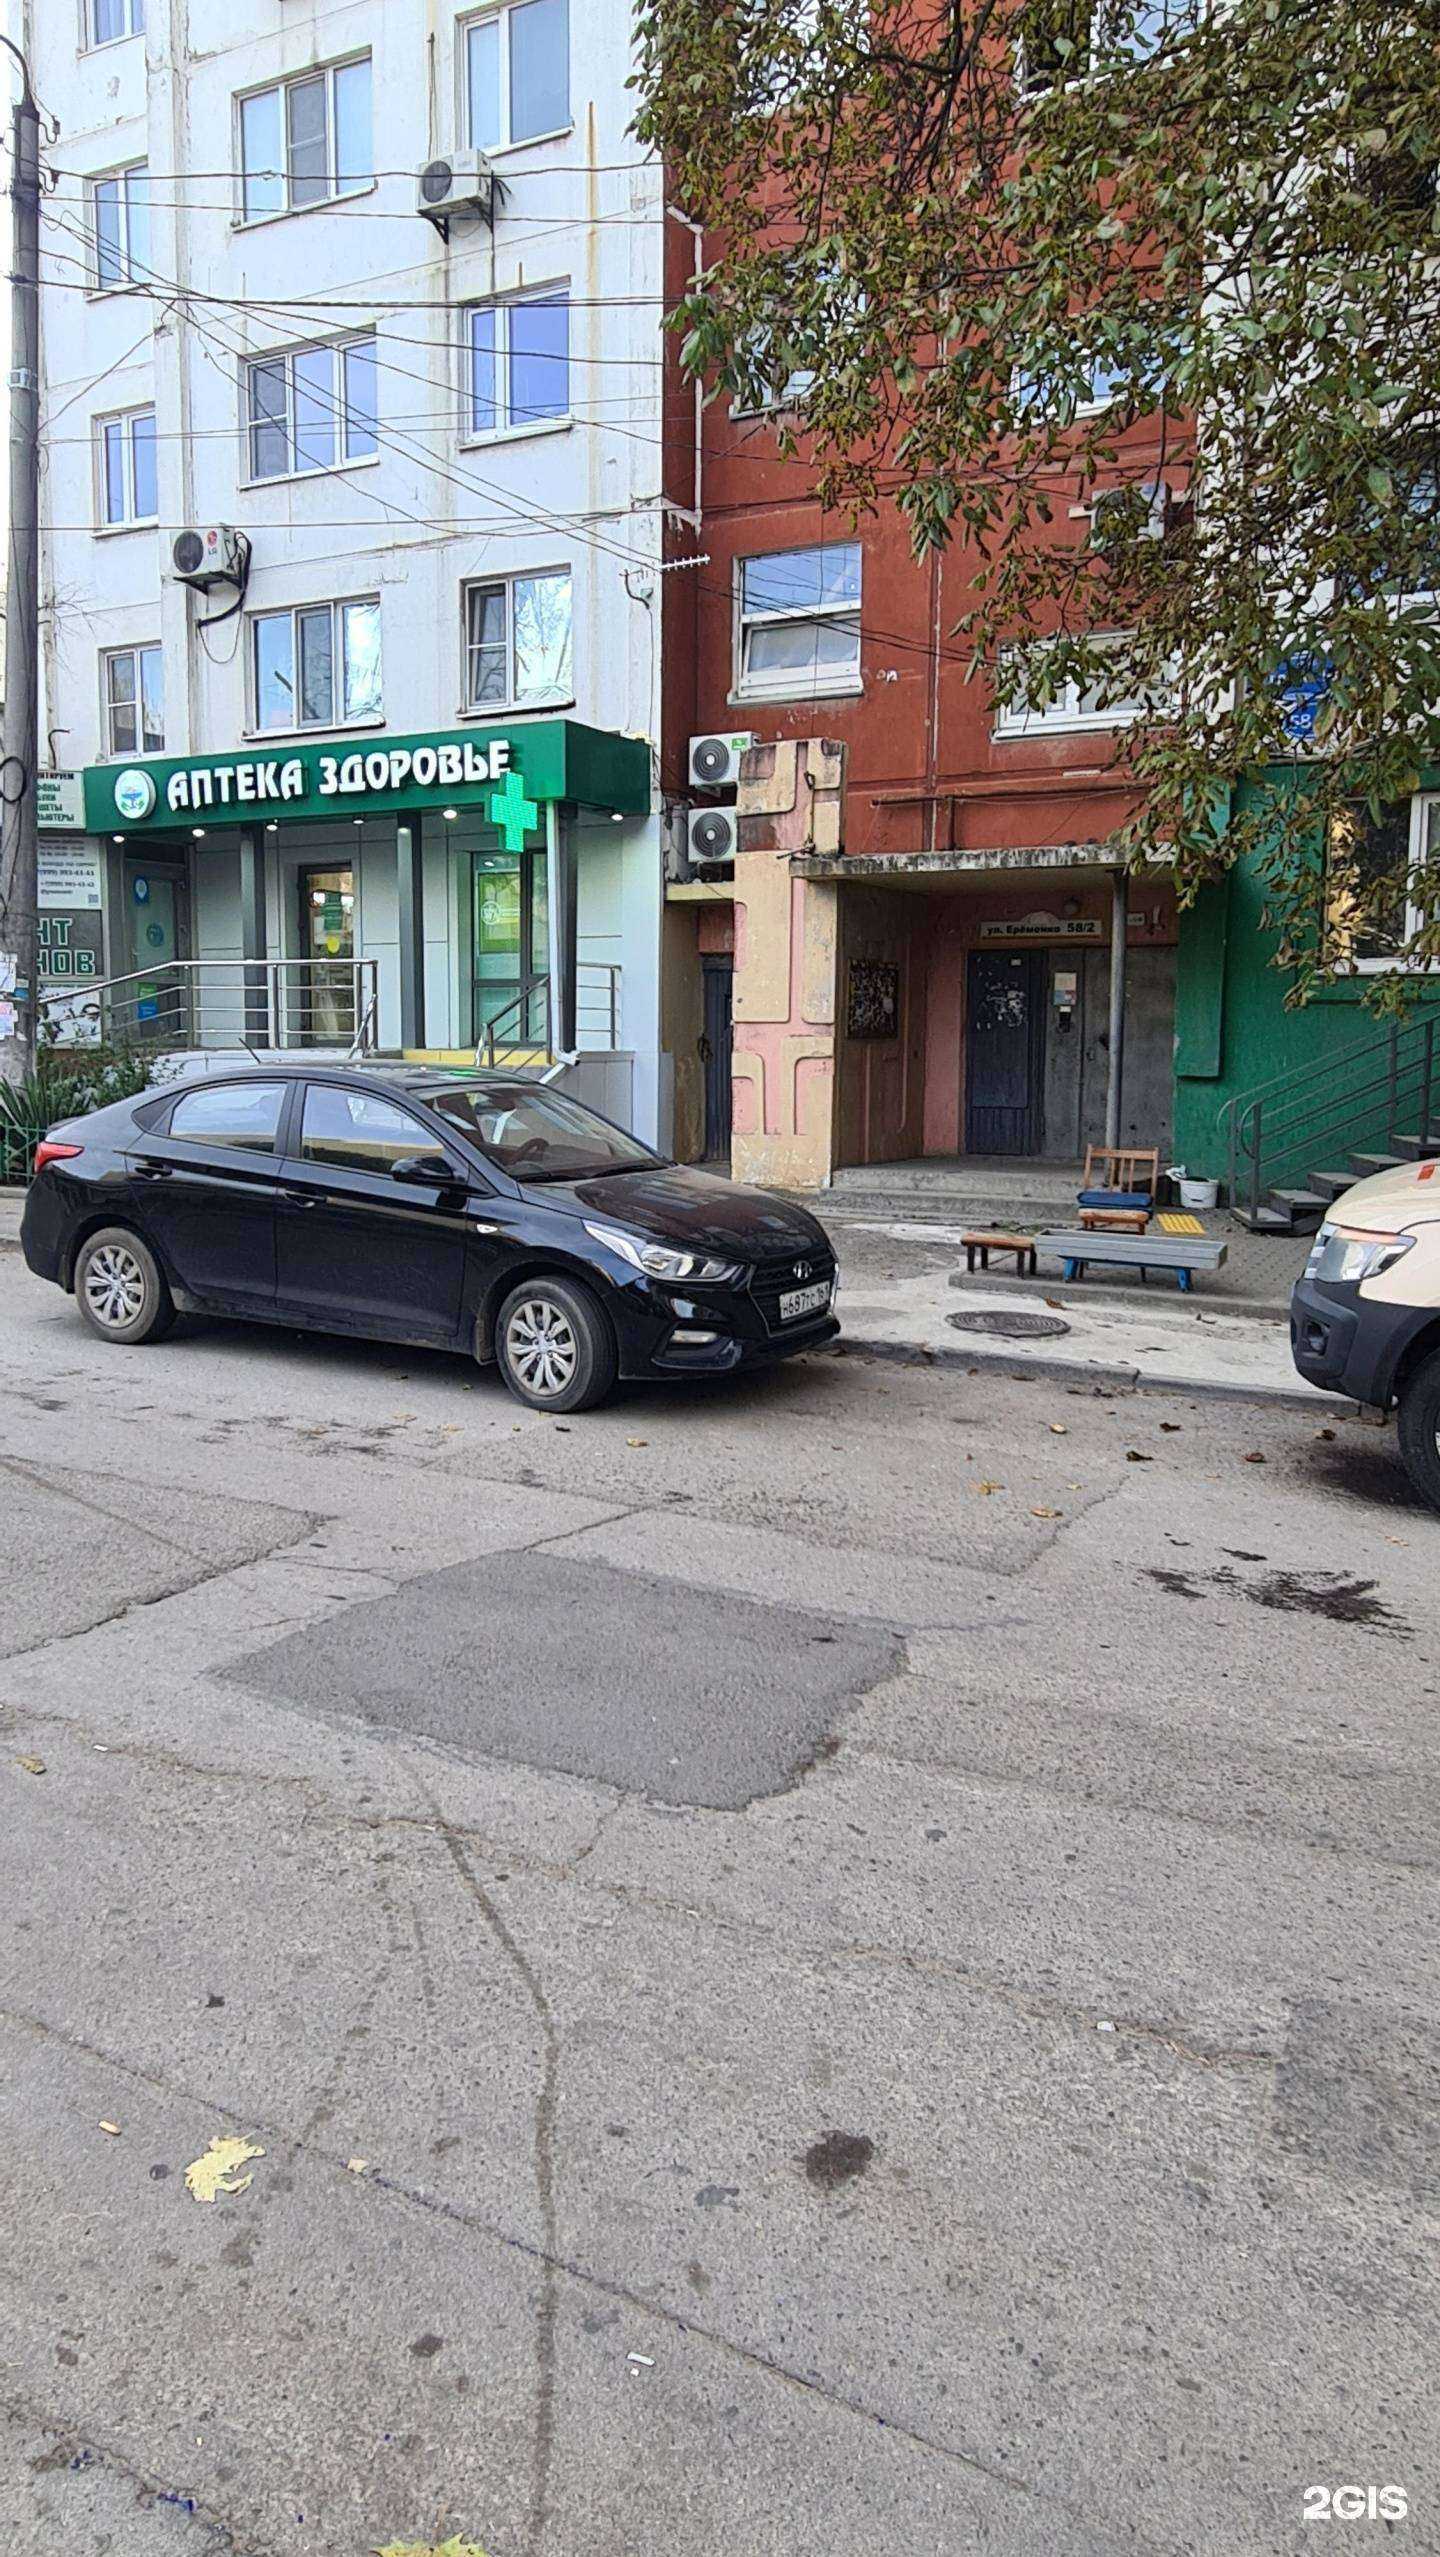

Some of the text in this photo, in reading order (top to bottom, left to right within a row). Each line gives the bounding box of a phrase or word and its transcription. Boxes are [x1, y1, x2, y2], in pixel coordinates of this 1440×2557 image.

[167, 739, 511, 811] АПТЕКА ЗДОРОВЬЕ
[37, 917, 73, 946] НТ
[987, 926, 1003, 936] ул.
[1067, 922, 1095, 933] 58/2
[37, 949, 96, 976] НОВ
